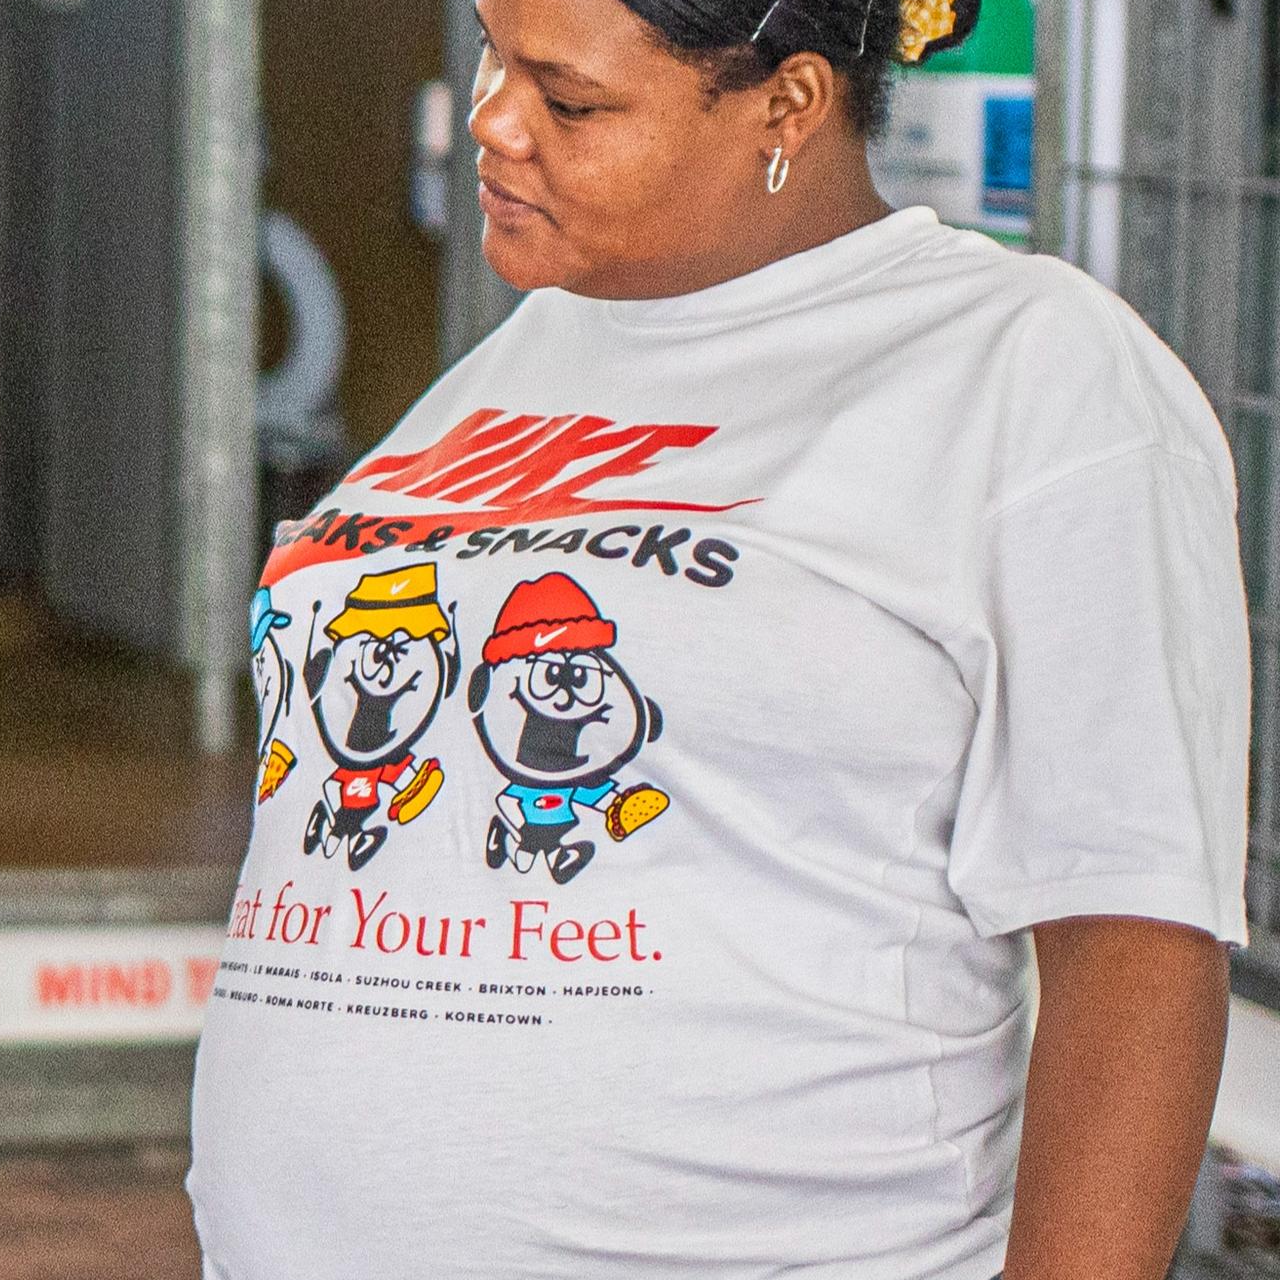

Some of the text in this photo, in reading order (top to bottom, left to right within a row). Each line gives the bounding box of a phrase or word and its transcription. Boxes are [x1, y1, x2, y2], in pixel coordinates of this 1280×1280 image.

[343, 408, 724, 508] NIKE
[404, 524, 448, 552] &
[455, 523, 740, 588] SNACKS
[266, 879, 333, 945] for
[349, 887, 487, 957] Your
[507, 899, 664, 962] Feet.
[37, 958, 173, 1007] MIND
[265, 966, 300, 979] MARAIS
[310, 971, 343, 983] ISOLA
[355, 975, 410, 990] SUZHOU
[415, 980, 462, 992] CREEK
[478, 983, 547, 996] BRIXTON
[563, 985, 644, 997] HAPJEONG
[265, 994, 293, 1008] ROMA
[296, 999, 334, 1012] NORTE
[346, 1004, 429, 1020] KREUZBERG
[445, 1011, 542, 1025] KOREATOWN
